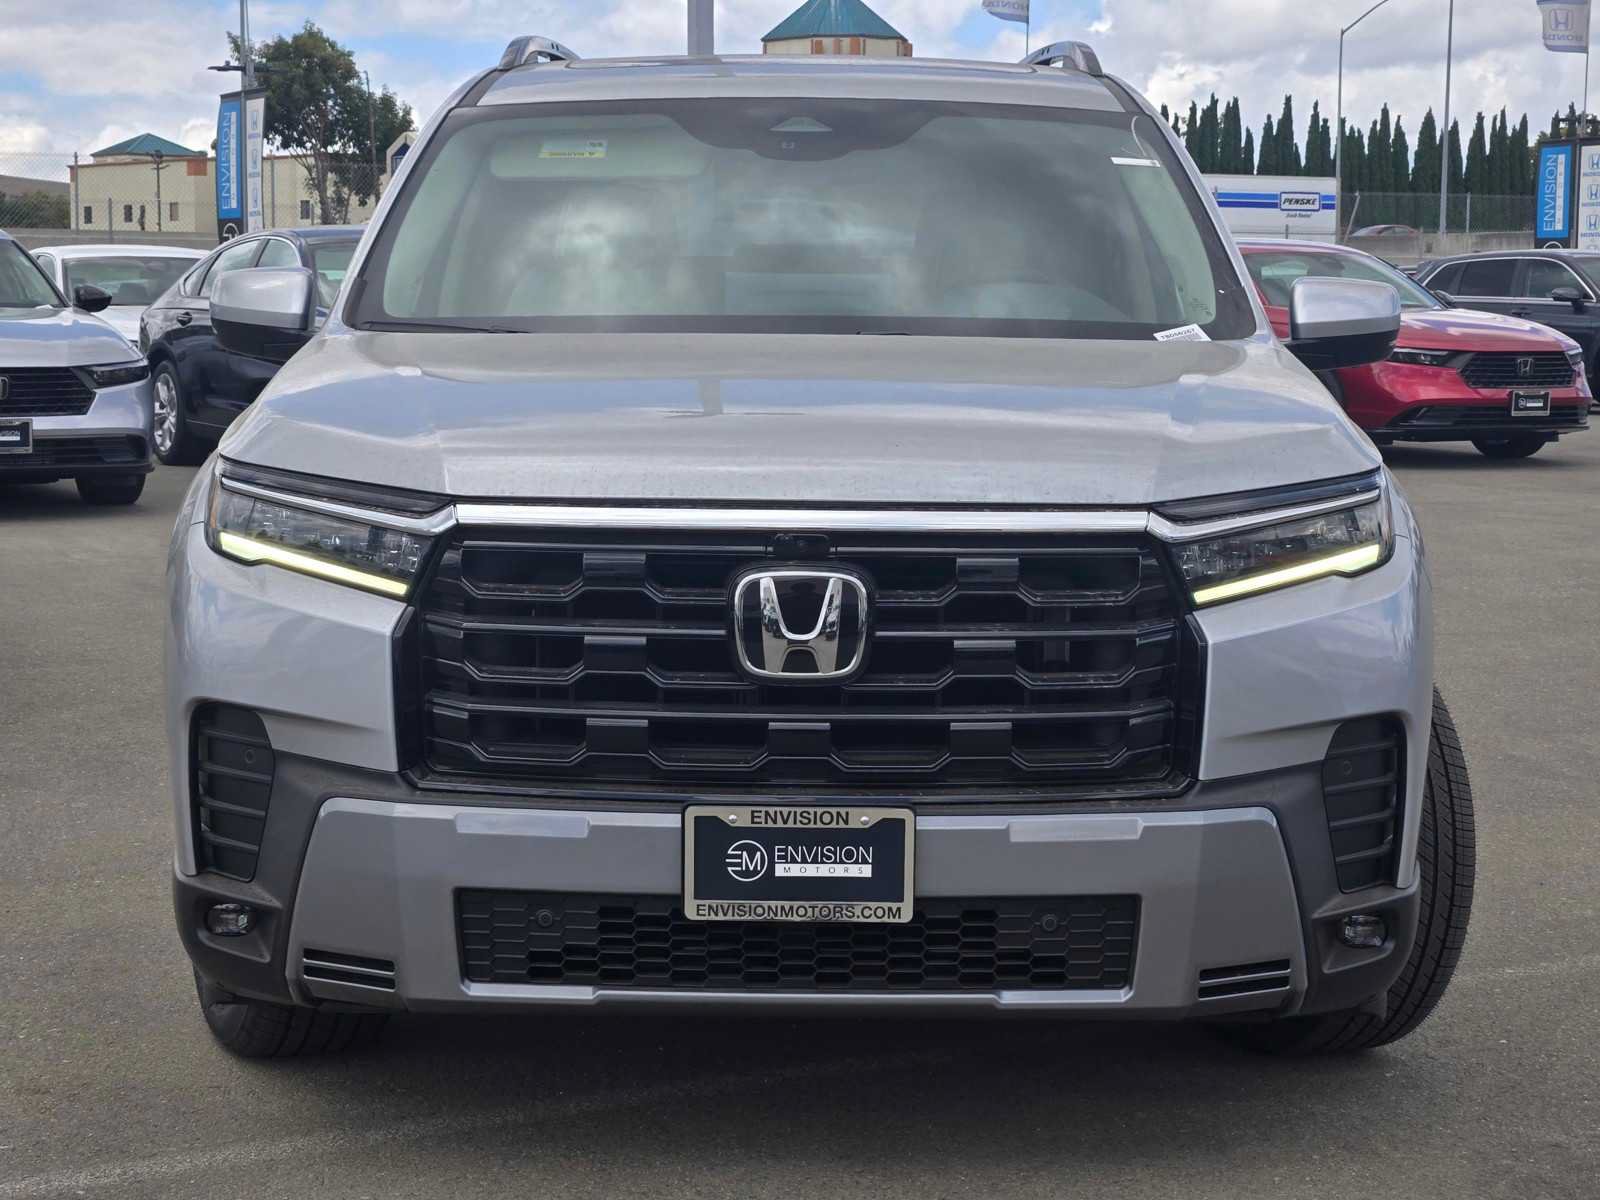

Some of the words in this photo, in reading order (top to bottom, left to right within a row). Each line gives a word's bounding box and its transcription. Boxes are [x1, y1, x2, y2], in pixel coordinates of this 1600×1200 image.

[221, 112, 232, 210] ENVISION
[1543, 154, 1557, 231] ENVISION
[1282, 197, 1318, 206] PENSKE
[750, 810, 850, 826] ENVISION
[774, 845, 873, 864] ENVISION
[783, 866, 865, 875] MOTORS
[696, 903, 902, 920] ENVISIONMOTORS.COM
